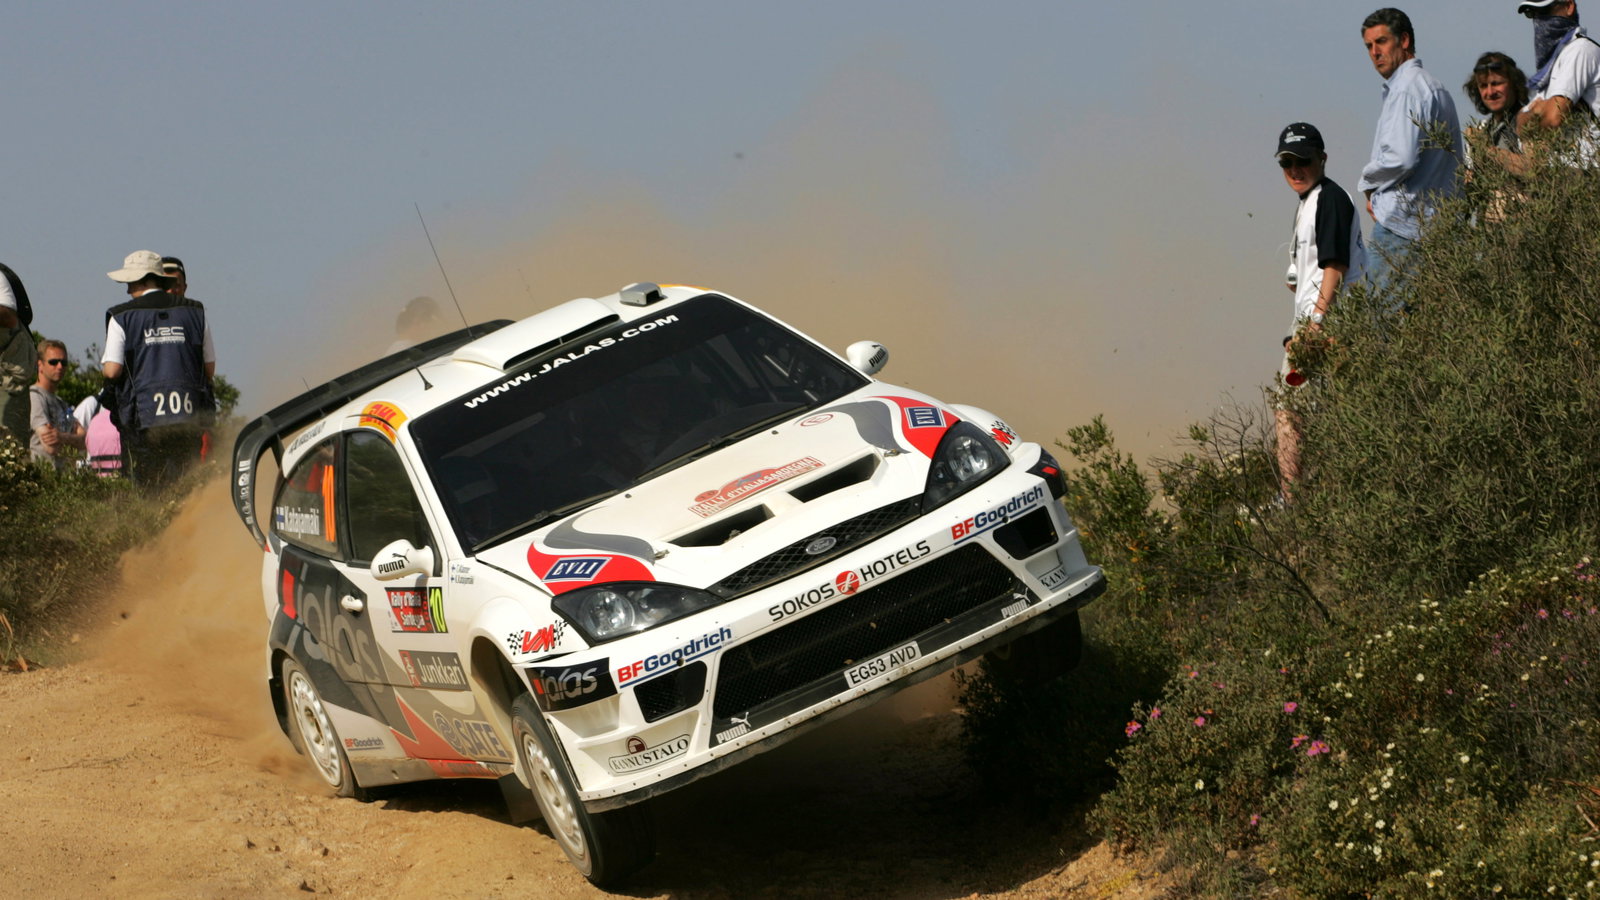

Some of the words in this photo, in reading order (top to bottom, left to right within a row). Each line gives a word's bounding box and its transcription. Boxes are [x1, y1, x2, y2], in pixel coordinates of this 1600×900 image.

[144, 326, 185, 338] WRC
[464, 314, 679, 409] WWW.JALAS.COM
[153, 391, 193, 416] 206
[321, 464, 337, 543] 10
[951, 486, 1045, 541] BFGoodrich
[378, 559, 406, 574] PUMA
[551, 561, 599, 577] EVLI
[768, 582, 836, 623] SOKOS
[859, 539, 932, 583] HOTELS
[430, 588, 447, 633] 10
[1001, 598, 1028, 620] PUMA
[521, 624, 556, 655] VM
[617, 627, 732, 683] BFGoodrich
[416, 656, 467, 687] Junkkari
[849, 657, 887, 685] EG53
[888, 645, 917, 668] AVD
[539, 667, 598, 711] jalas
[344, 737, 384, 748] BFGoodrich
[716, 723, 748, 744] PUMA
[611, 738, 690, 771] KANNUSTALO
